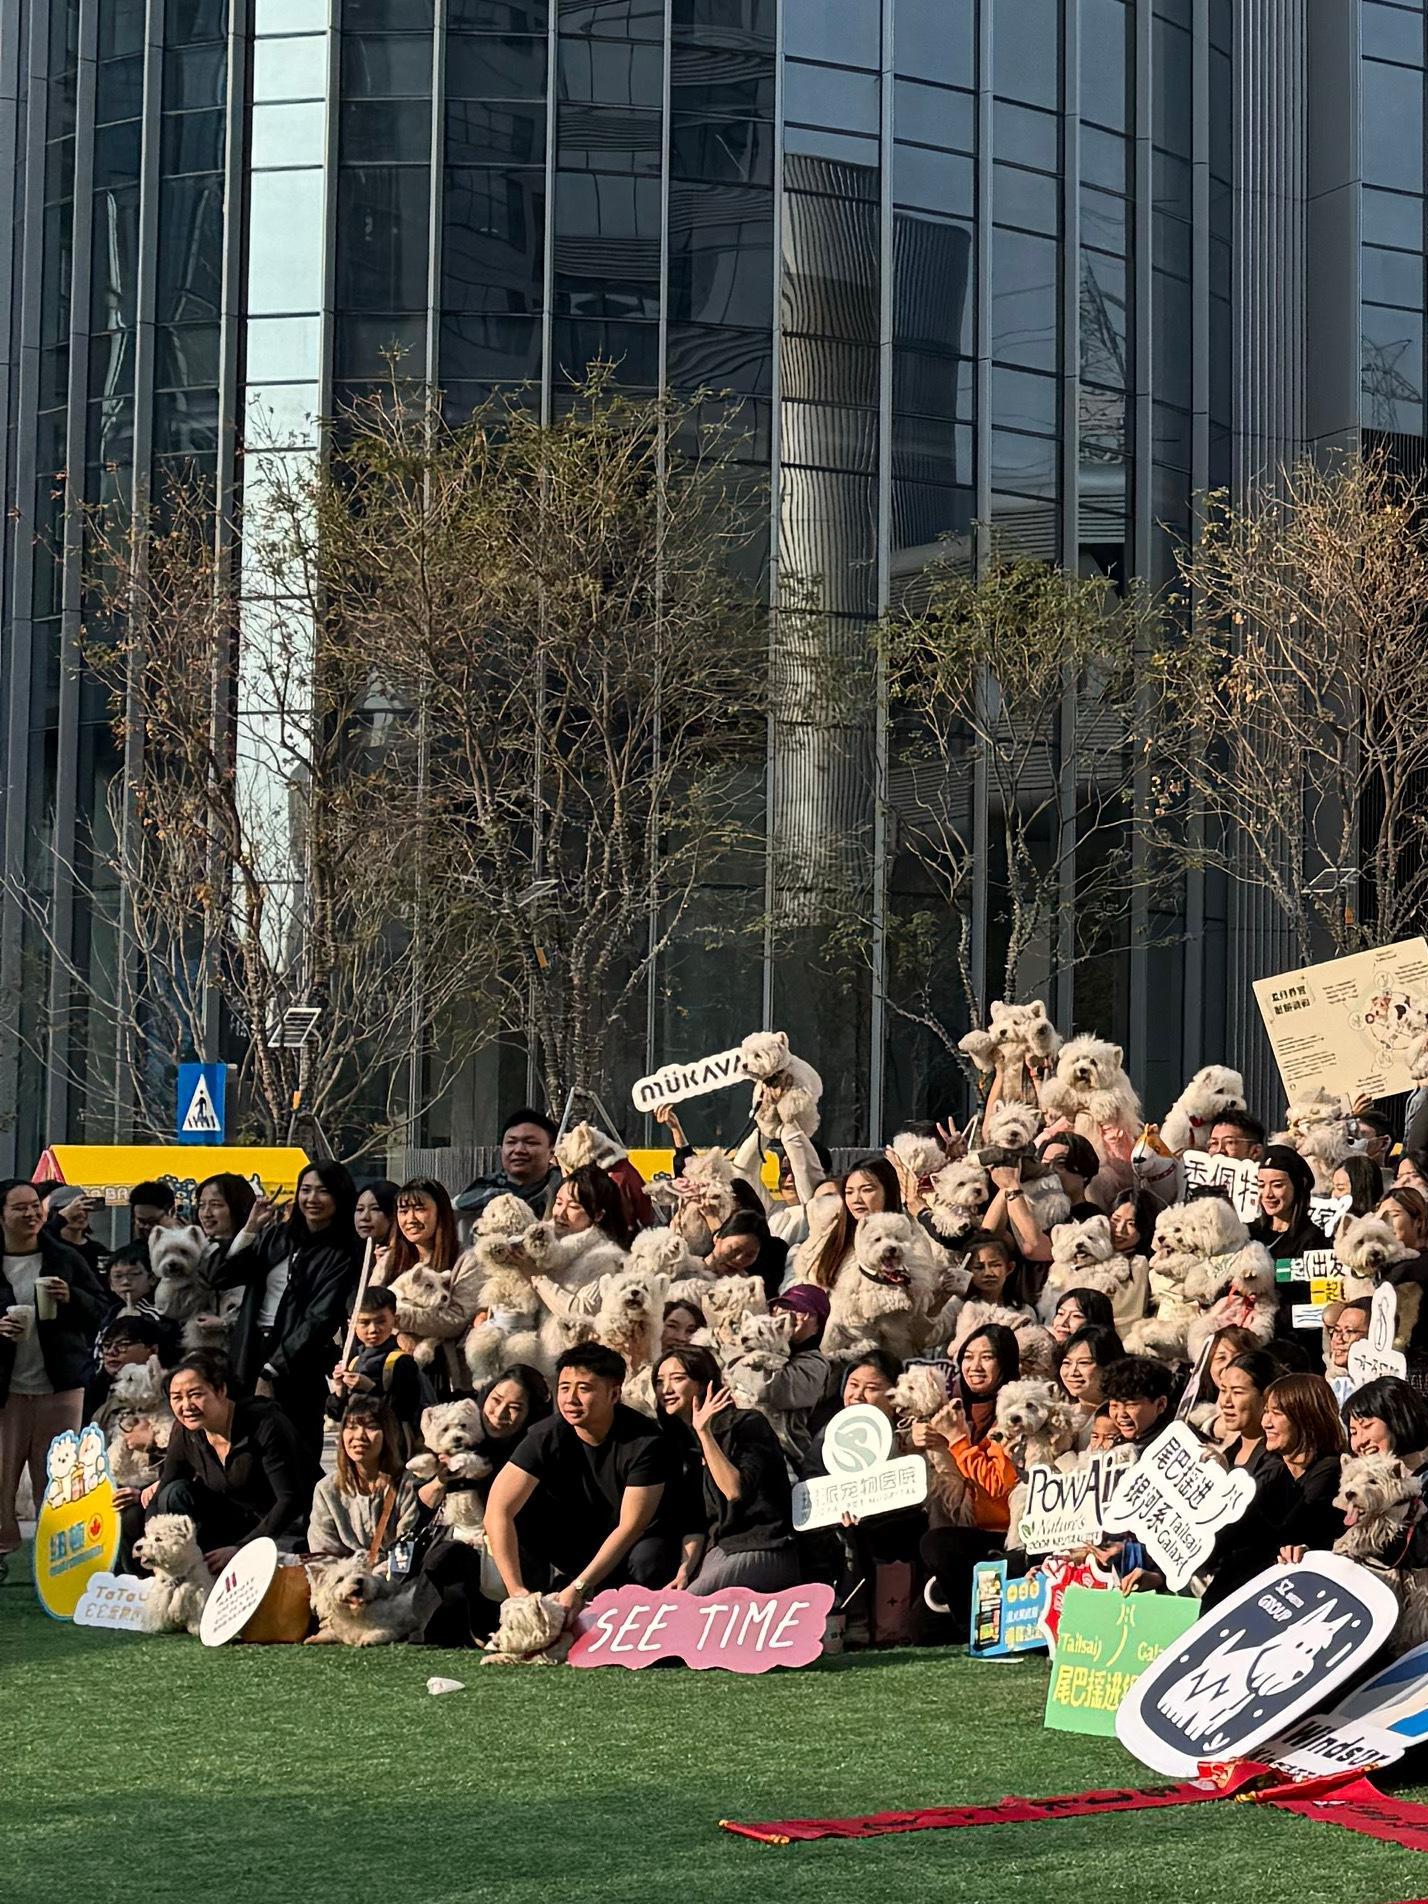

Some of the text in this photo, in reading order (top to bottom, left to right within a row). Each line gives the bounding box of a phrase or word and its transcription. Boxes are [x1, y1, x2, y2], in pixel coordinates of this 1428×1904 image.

[1123, 1472, 1174, 1535] 银河系
[1151, 1435, 1215, 1510] 尾巴摇进
[587, 1598, 811, 1652] SEE TIME
